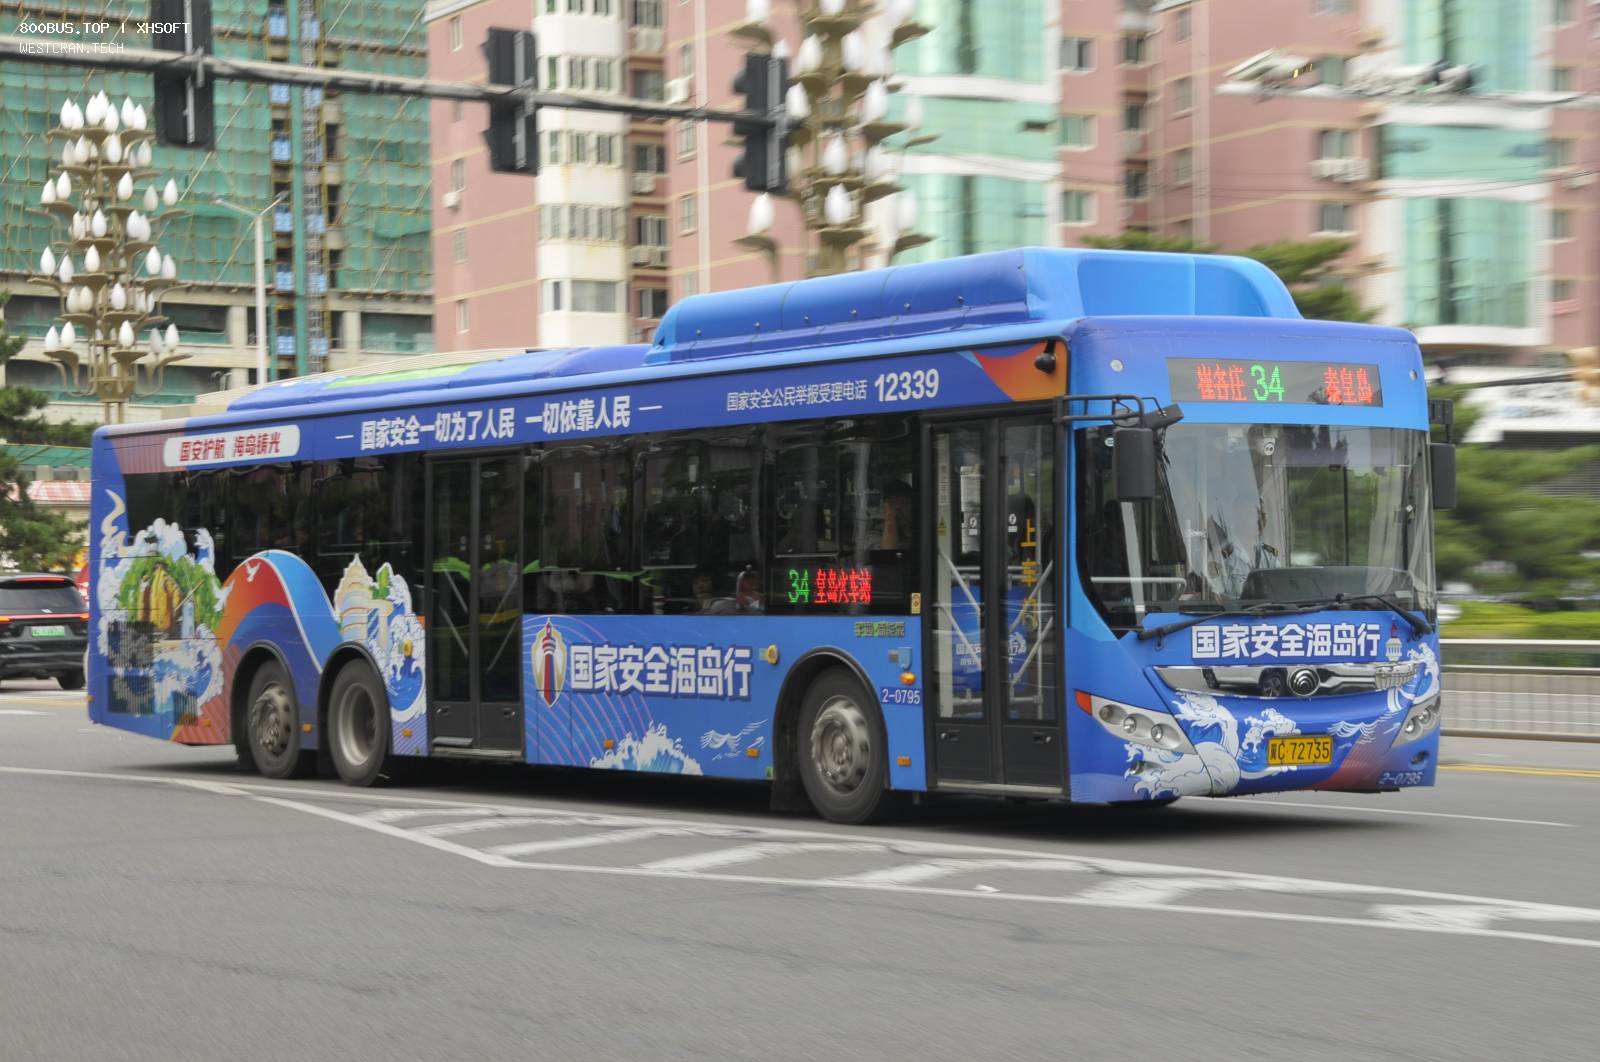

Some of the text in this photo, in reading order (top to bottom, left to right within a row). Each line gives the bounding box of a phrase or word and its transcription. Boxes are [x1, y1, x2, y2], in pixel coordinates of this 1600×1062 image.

[727, 368, 939, 412] 国家安全公民举报受理电话 12339
[1251, 365, 1285, 402] 34
[360, 407, 515, 450] 国家安全一切为了人民
[525, 395, 631, 433] 一切依靠人民
[788, 568, 810, 604] 34
[1192, 623, 1381, 659] 国家安全海岛行
[570, 644, 752, 697] 国家安全海岛行
[882, 688, 921, 704] 2-0795
[1379, 771, 1424, 785] 2-0795
